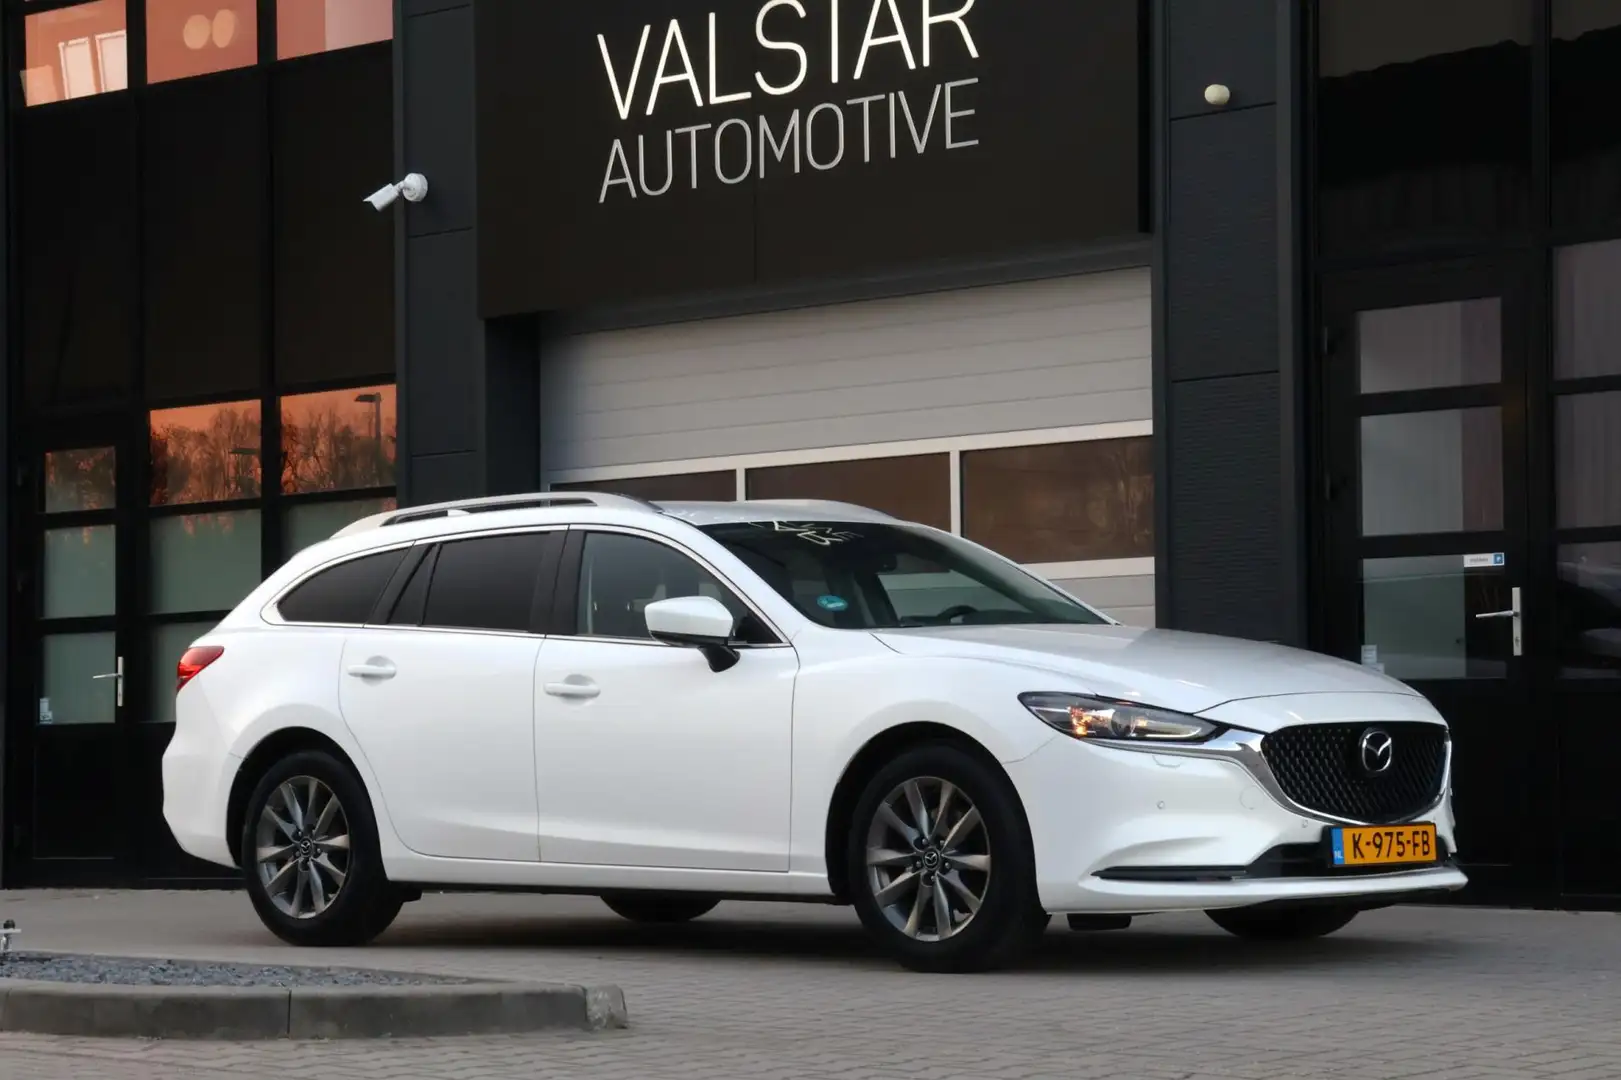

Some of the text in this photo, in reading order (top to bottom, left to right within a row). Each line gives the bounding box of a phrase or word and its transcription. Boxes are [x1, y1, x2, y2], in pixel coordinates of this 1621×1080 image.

[597, 0, 979, 120] VALSTAR
[599, 78, 979, 203] AUTOMOTIVE
[1352, 831, 1430, 859] K-975-FB
